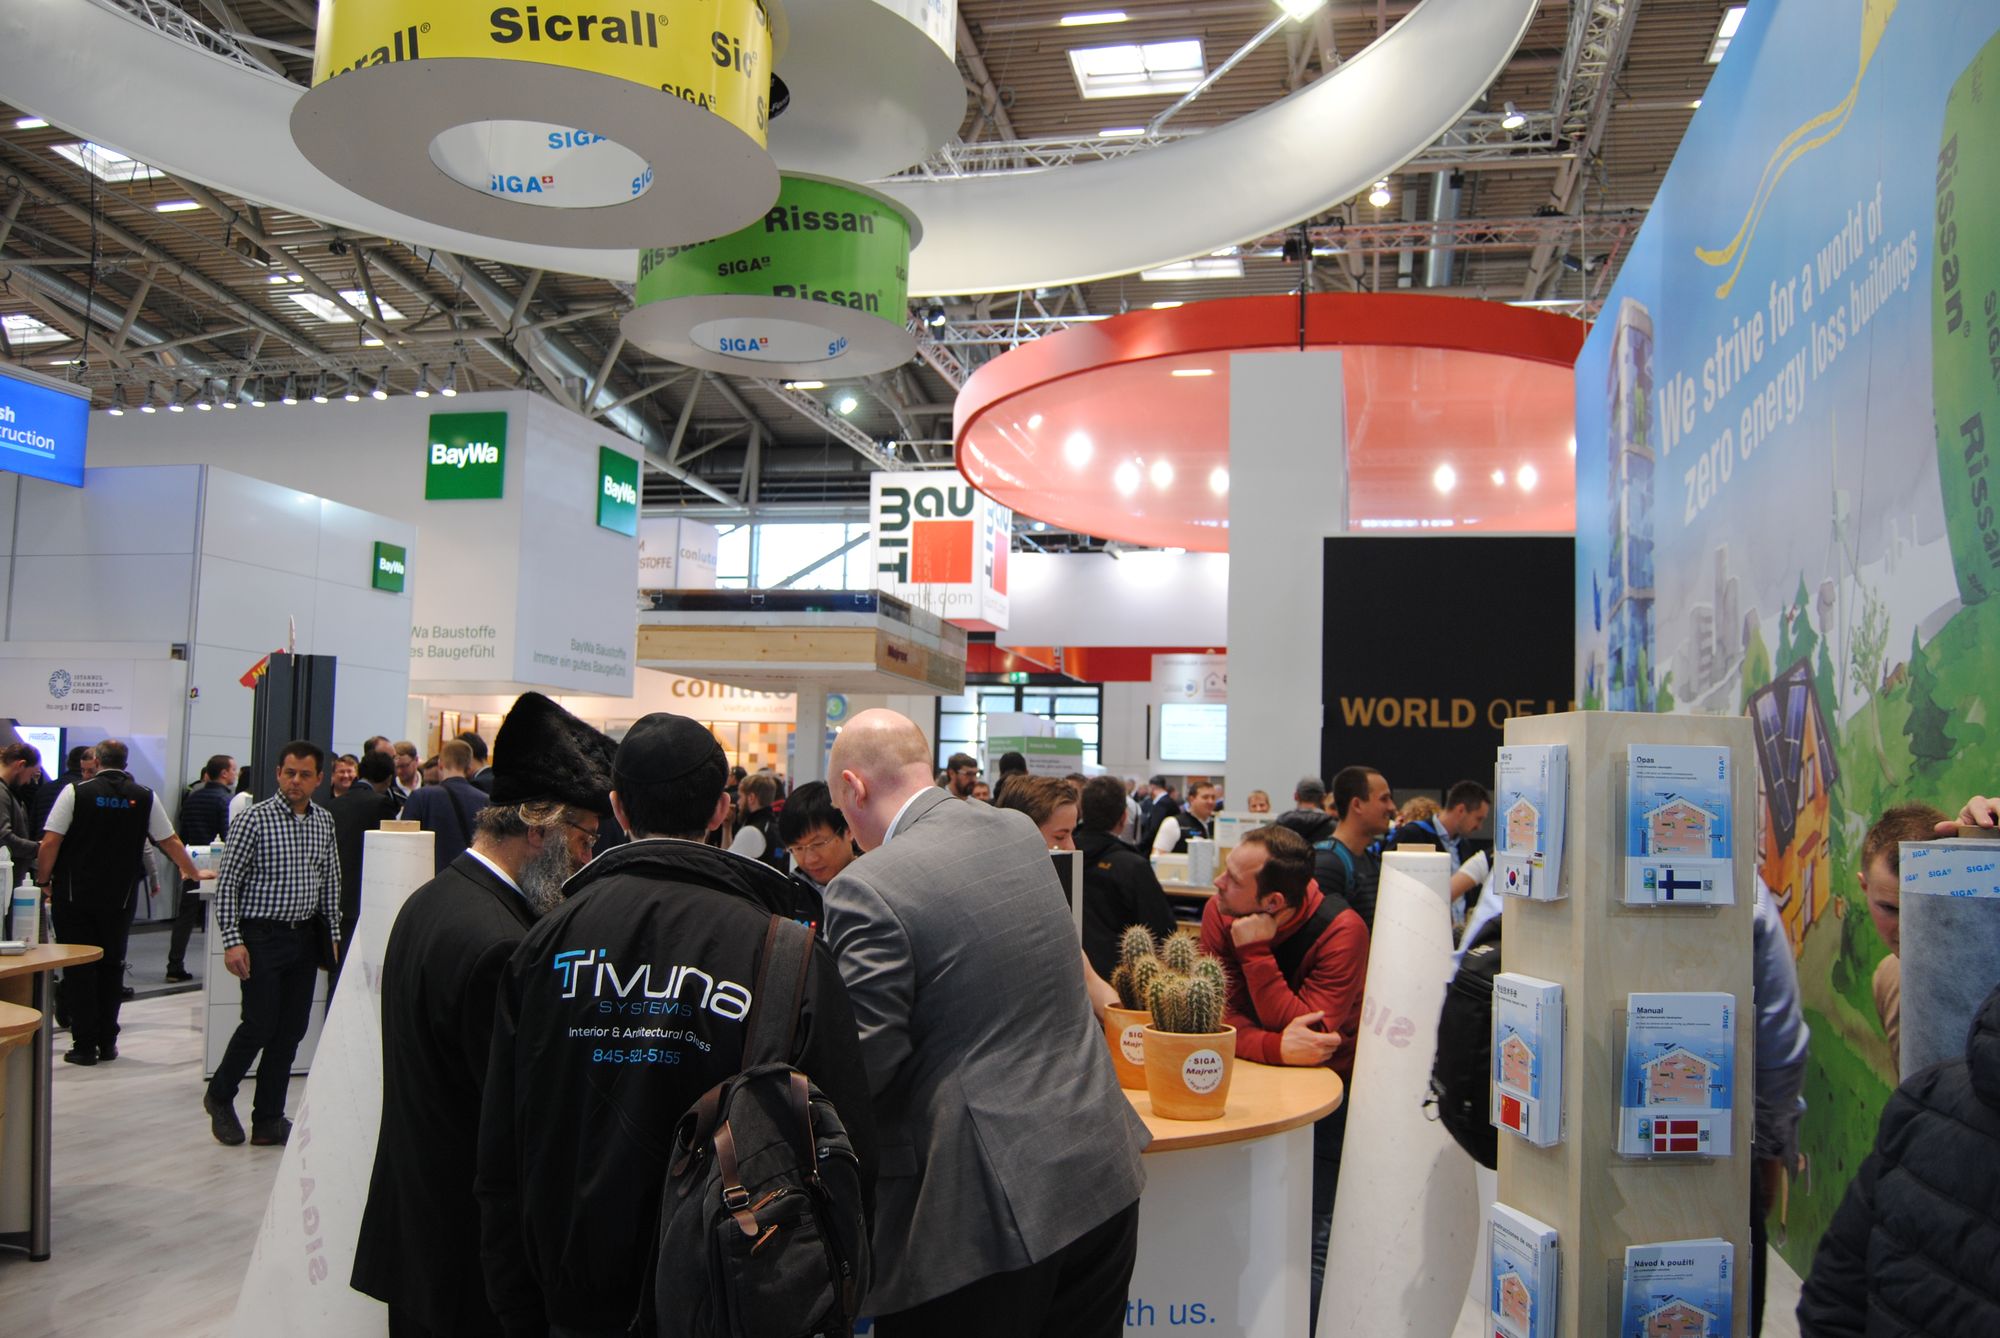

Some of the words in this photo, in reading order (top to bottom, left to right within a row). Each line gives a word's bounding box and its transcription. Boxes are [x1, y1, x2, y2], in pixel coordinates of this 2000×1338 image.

[718, 258, 762, 276] SIGA
[1659, 371, 1695, 457] We
[1703, 311, 1764, 413] strive
[1769, 276, 1796, 346] for
[1802, 263, 1813, 312] a
[1817, 200, 1863, 294] world
[1868, 181, 1882, 245] of
[720, 338, 760, 351] SIGA
[1684, 428, 1733, 527] zero
[1740, 346, 1807, 461] energy
[1812, 306, 1846, 381] loss
[1851, 230, 1917, 336] buildings
[431, 442, 498, 469] BayWa
[604, 475, 636, 505] BayWa
[380, 558, 404, 575] BayWa
[432, 625, 496, 639] Baustoffe
[428, 645, 495, 661] Baugefühl
[571, 638, 594, 655] BayWa
[1340, 697, 1477, 729] WORLD
[1636, 756, 1655, 764] Opas
[96, 796, 129, 809] SIGA
[1928, 870, 1949, 878] SIGA
[1966, 864, 1991, 873] SIGA
[553, 948, 752, 1022] Tivuna
[569, 1026, 609, 1038] Interior
[612, 1026, 620, 1037] &
[1194, 1057, 1216, 1065] SIGA
[1634, 1258, 1658, 1267] Návod
[1169, 1302, 1215, 1325] us.
